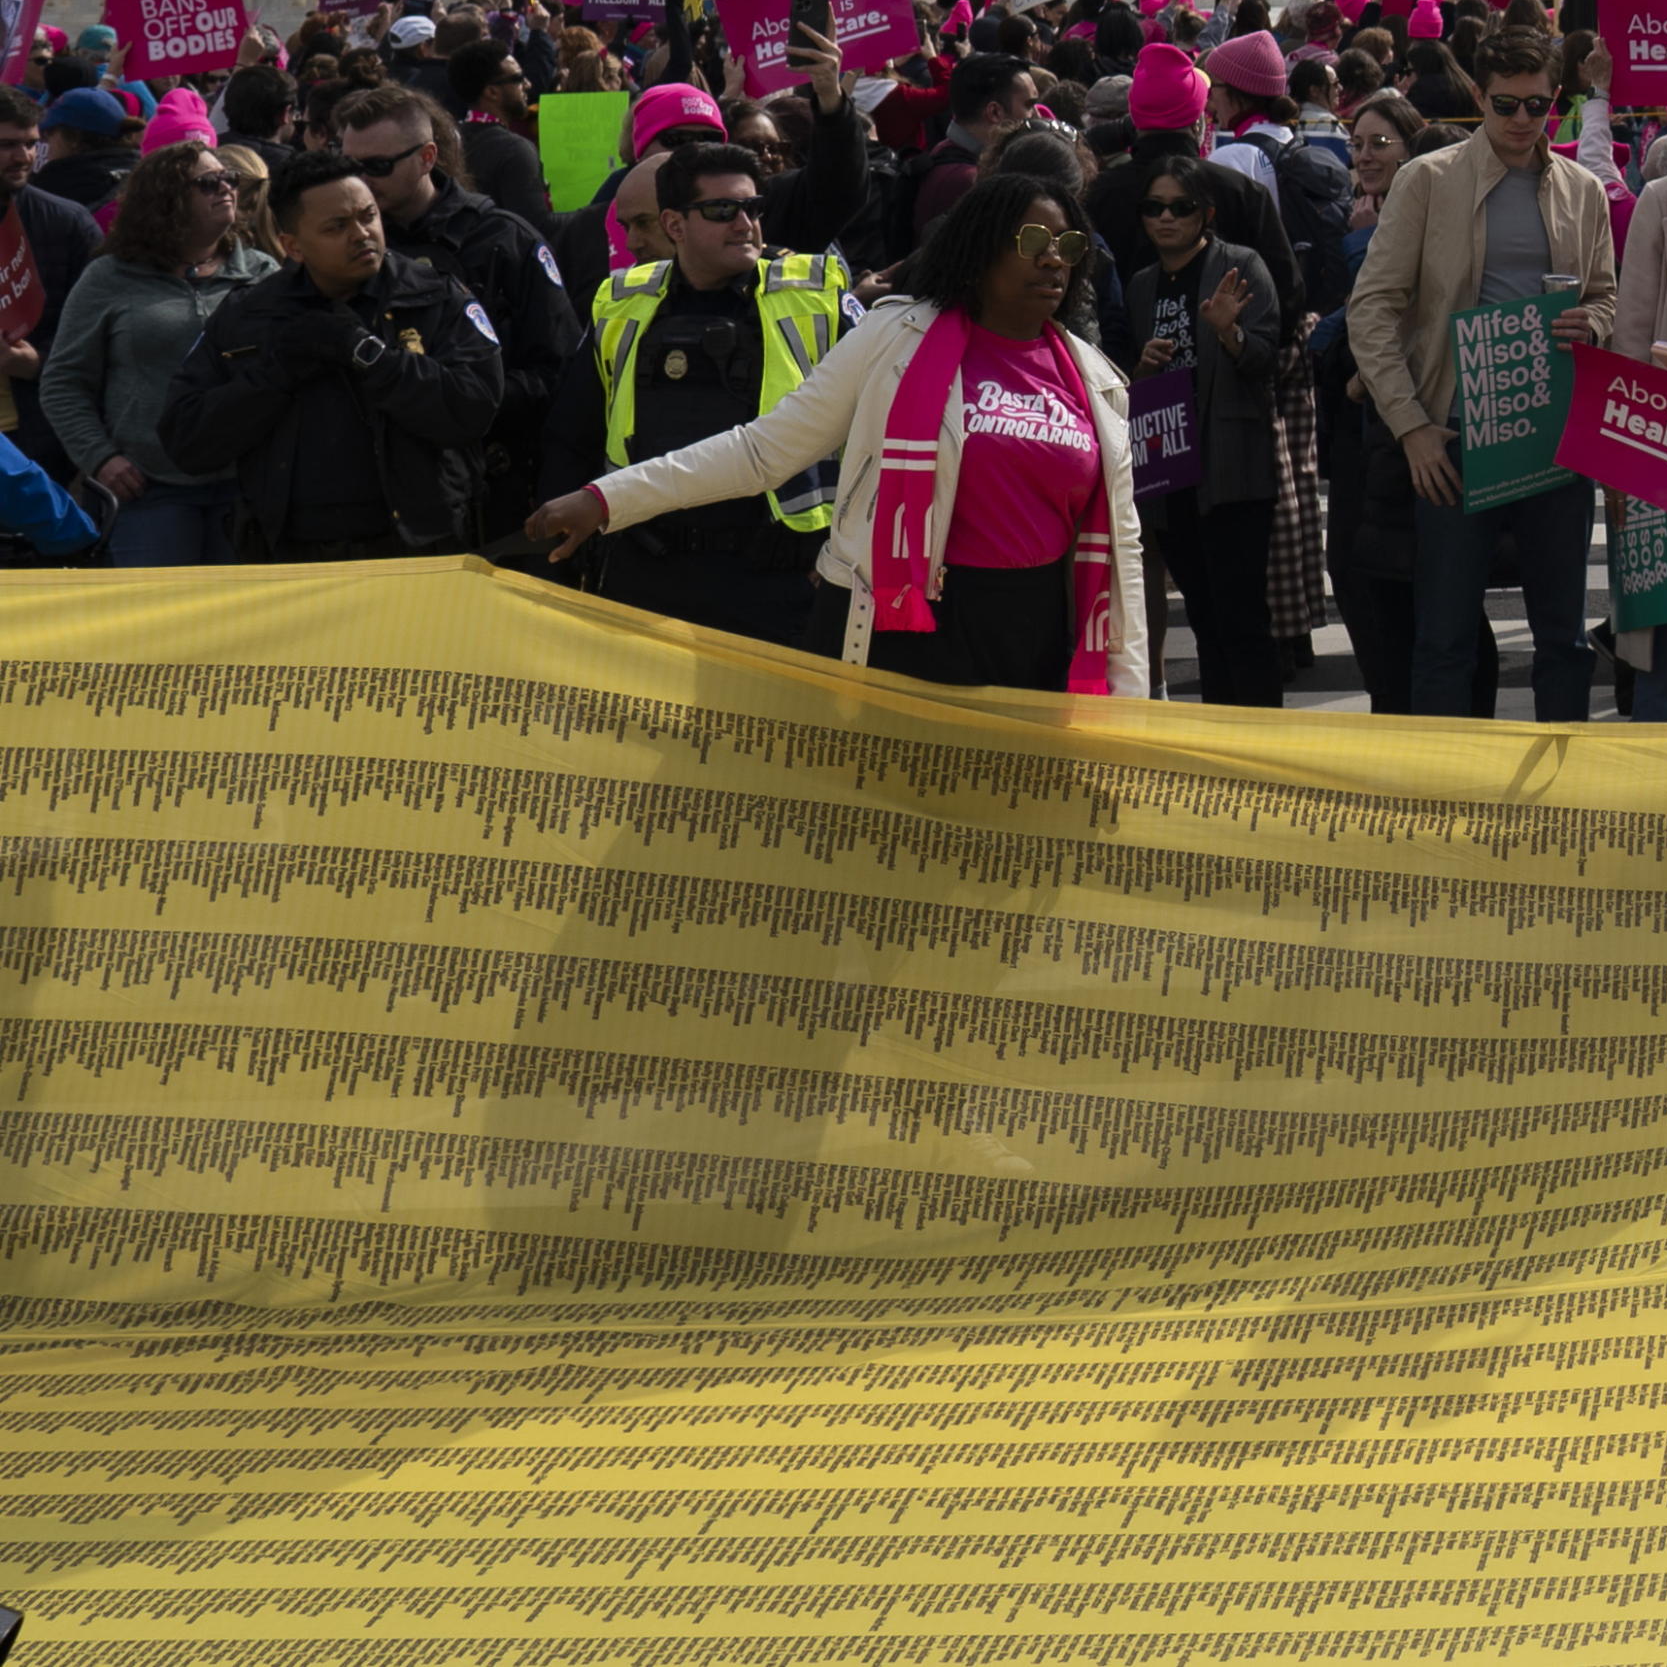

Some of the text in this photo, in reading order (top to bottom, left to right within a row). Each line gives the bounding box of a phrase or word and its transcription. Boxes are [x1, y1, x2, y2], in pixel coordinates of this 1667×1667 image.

[144, 7, 238, 40] OFF OUR
[148, 28, 237, 62] BODIES
[1456, 304, 1543, 345] Mife&
[1459, 329, 1550, 372] Miso&
[1462, 355, 1551, 398] Miso&
[1049, 399, 1078, 428] DE
[1464, 382, 1552, 425] Miso&
[963, 403, 1092, 453] CONTROLARNOS
[1162, 429, 1191, 459] ALL
[1466, 418, 1537, 451] Miso.
